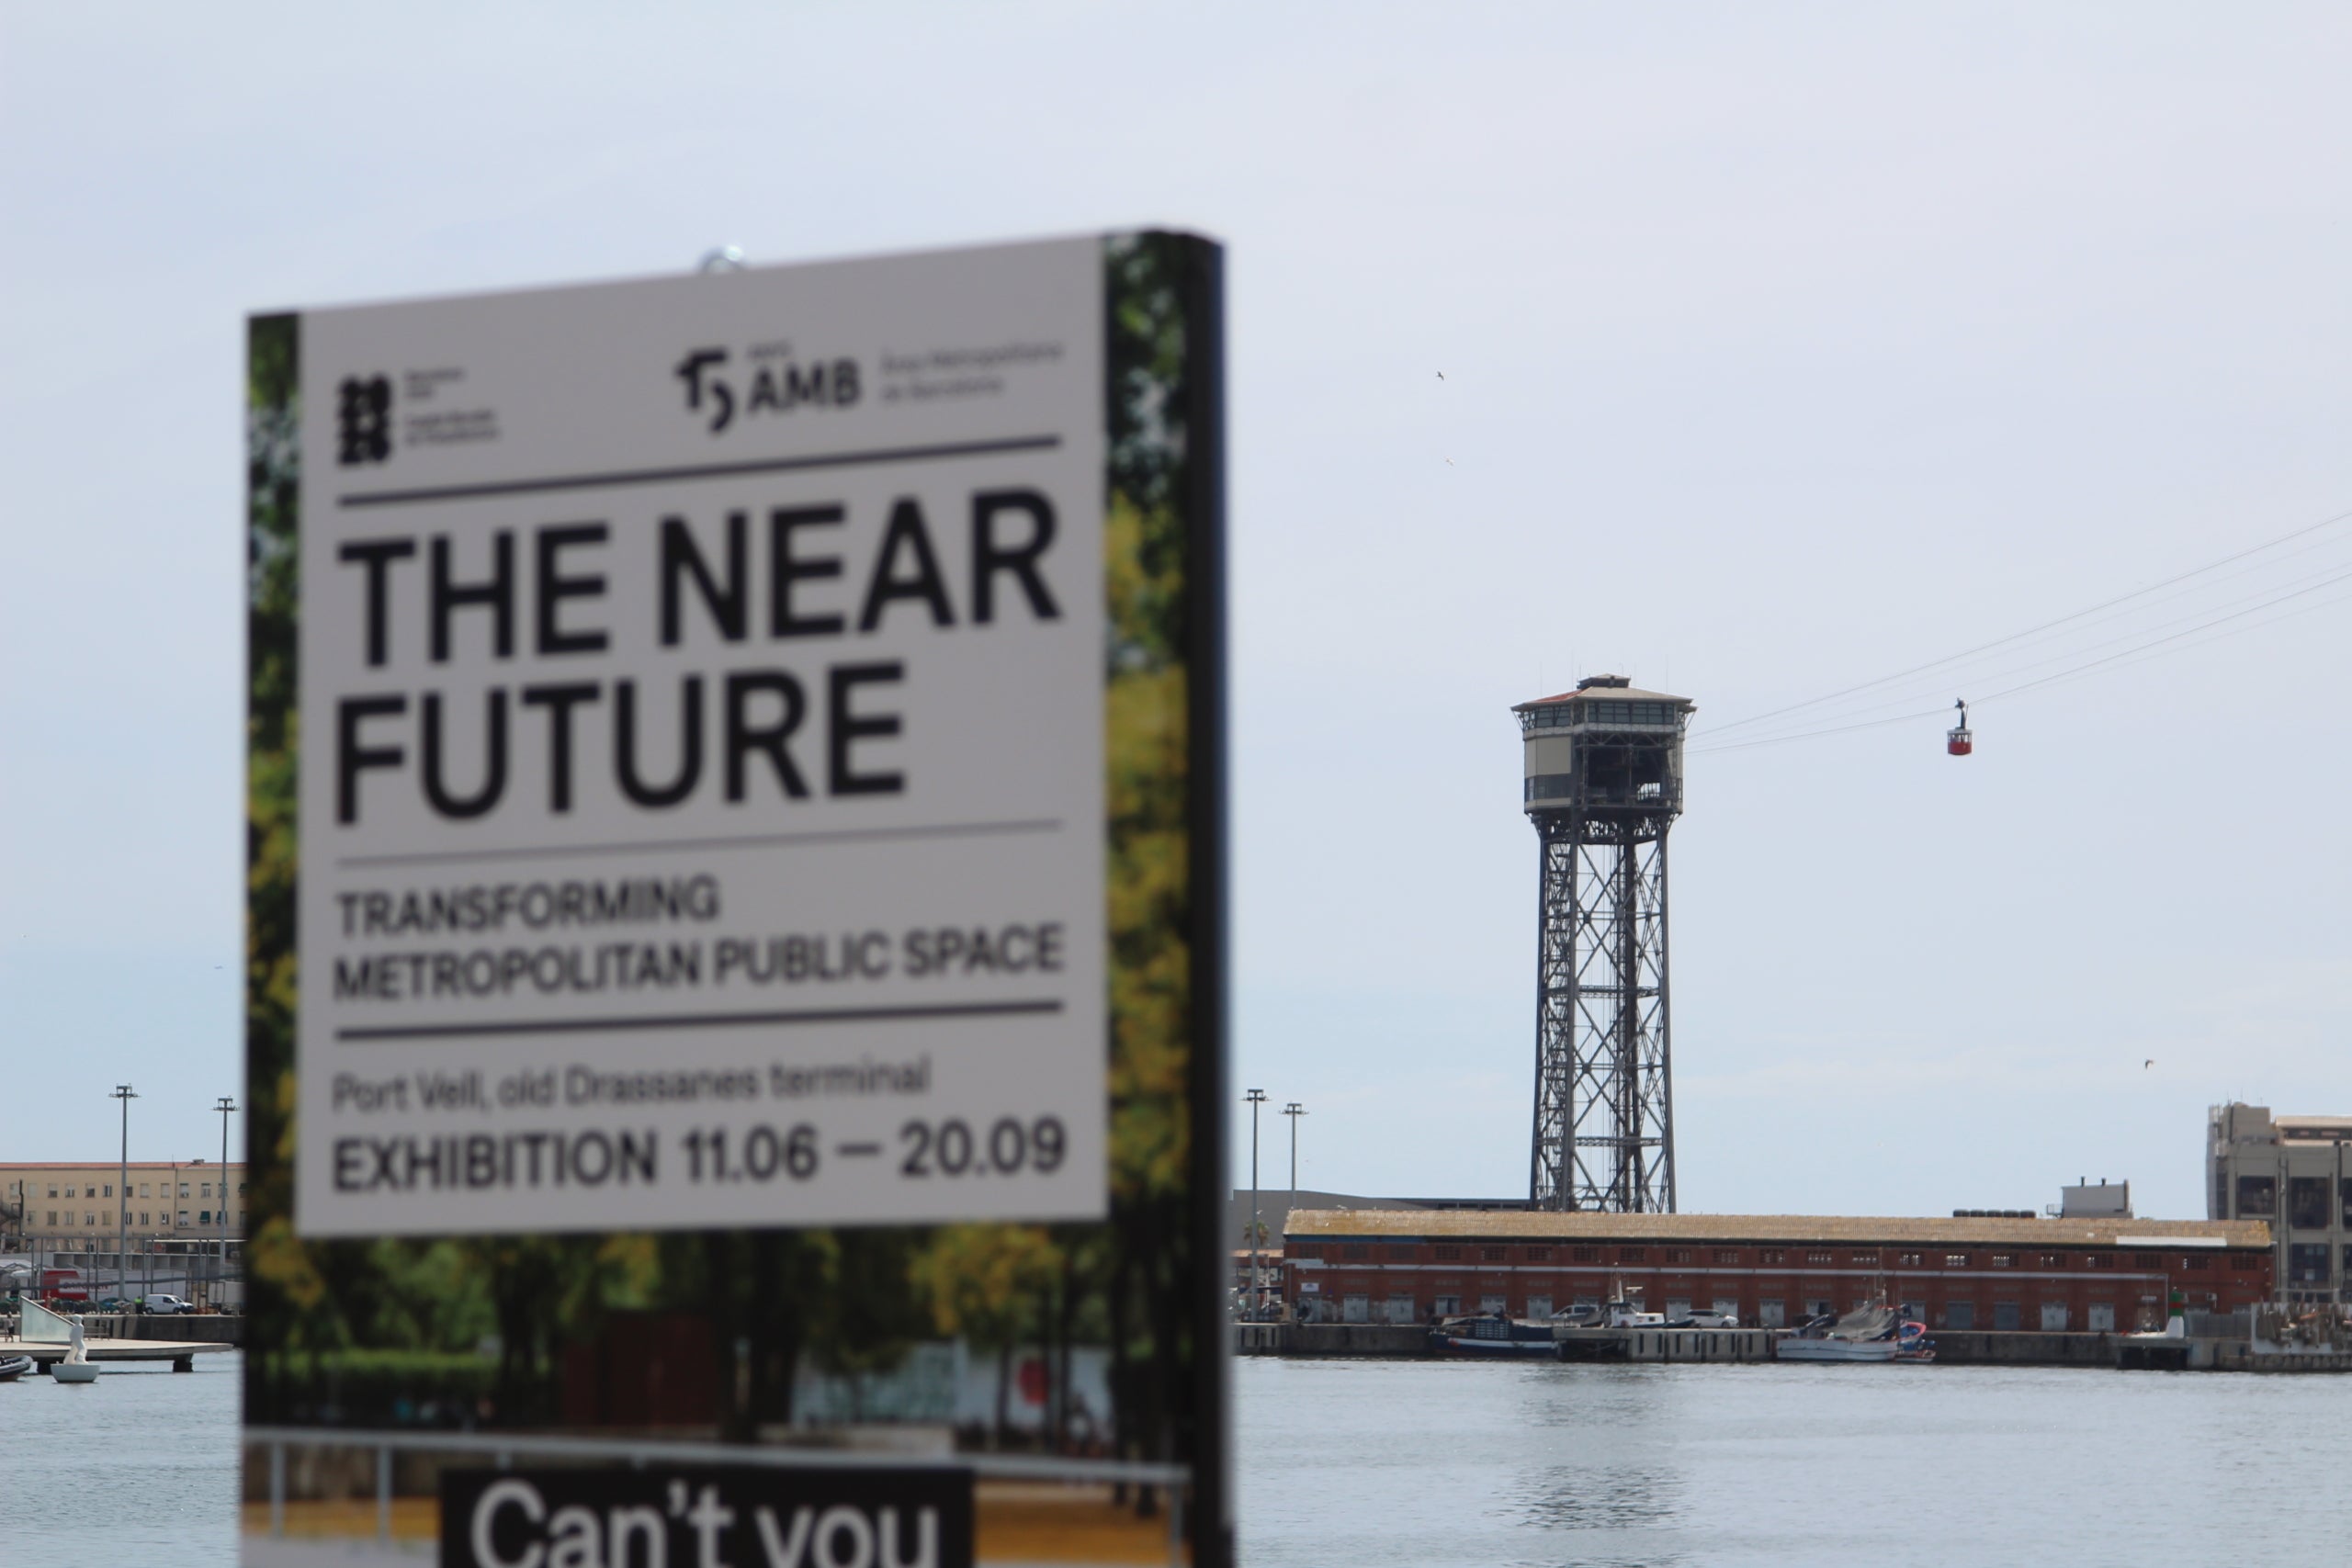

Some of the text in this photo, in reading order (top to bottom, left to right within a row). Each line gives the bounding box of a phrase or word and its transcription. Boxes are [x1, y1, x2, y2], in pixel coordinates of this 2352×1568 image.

[744, 356, 864, 415] AMB
[336, 486, 1063, 668] THE NEAR
[334, 660, 907, 827] FUTURE
[334, 873, 721, 939] TRANSFORMING
[331, 921, 1066, 1001] METROPOLITAN PUBLIC SPACE
[331, 1072, 408, 1113] Port
[496, 1066, 555, 1108] old
[563, 1057, 761, 1108] Drassanes
[769, 1054, 932, 1099] terminal
[331, 1128, 659, 1194] EXHIBITION
[682, 1122, 820, 1185] 11.06
[898, 1114, 1069, 1180] 20.09
[753, 1505, 939, 1568] you
